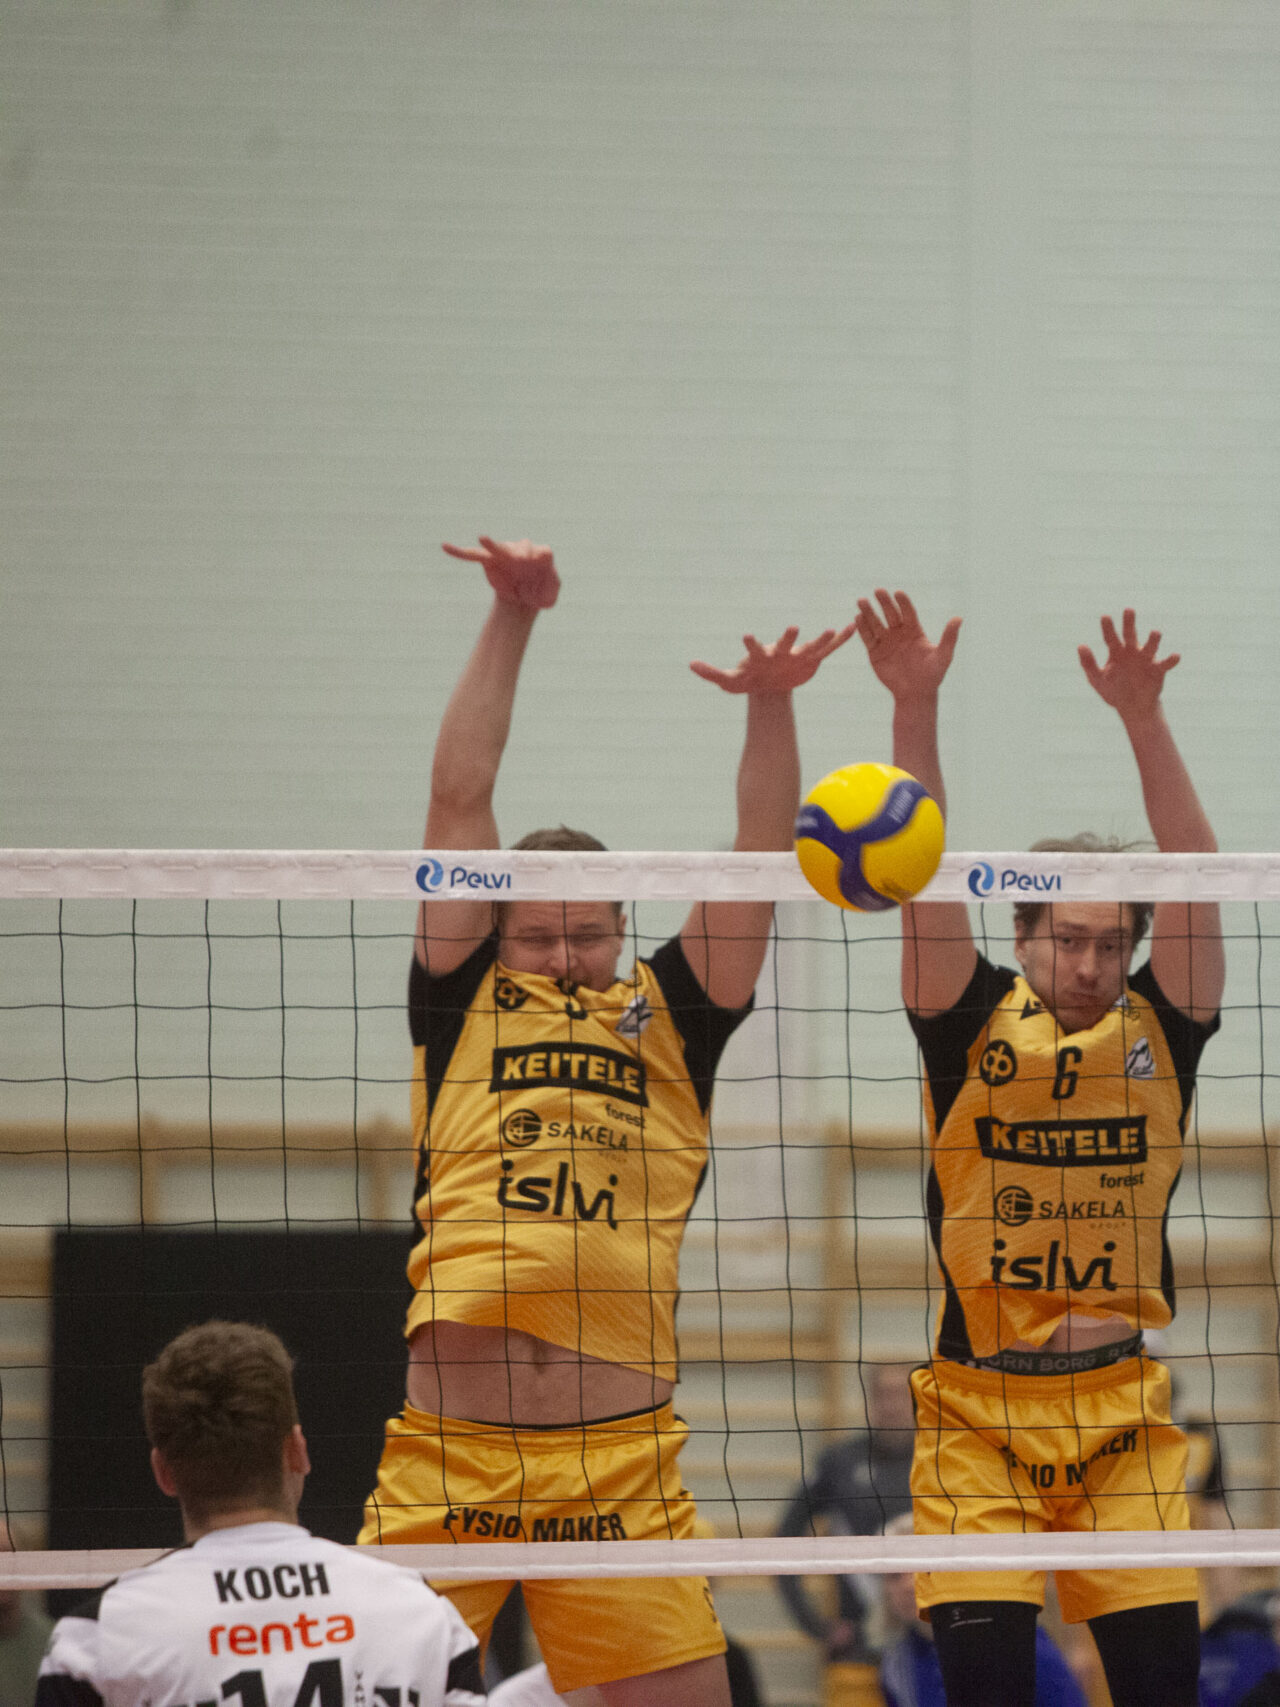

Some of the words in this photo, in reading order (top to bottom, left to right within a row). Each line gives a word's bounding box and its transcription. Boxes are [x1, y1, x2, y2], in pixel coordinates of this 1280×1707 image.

[503, 1051, 641, 1094] KEITELE
[1052, 1046, 1083, 1100] 6
[605, 1103, 646, 1128] forest
[547, 1122, 628, 1152] SAKELA
[991, 1124, 1139, 1157] KEITELE
[1100, 1171, 1144, 1189] forest
[1039, 1200, 1126, 1218] SAKELA
[443, 1507, 521, 1538] FYSIO
[532, 1513, 627, 1542] MAKER
[214, 1563, 330, 1602] KOCH
[209, 1613, 355, 1656] renta
